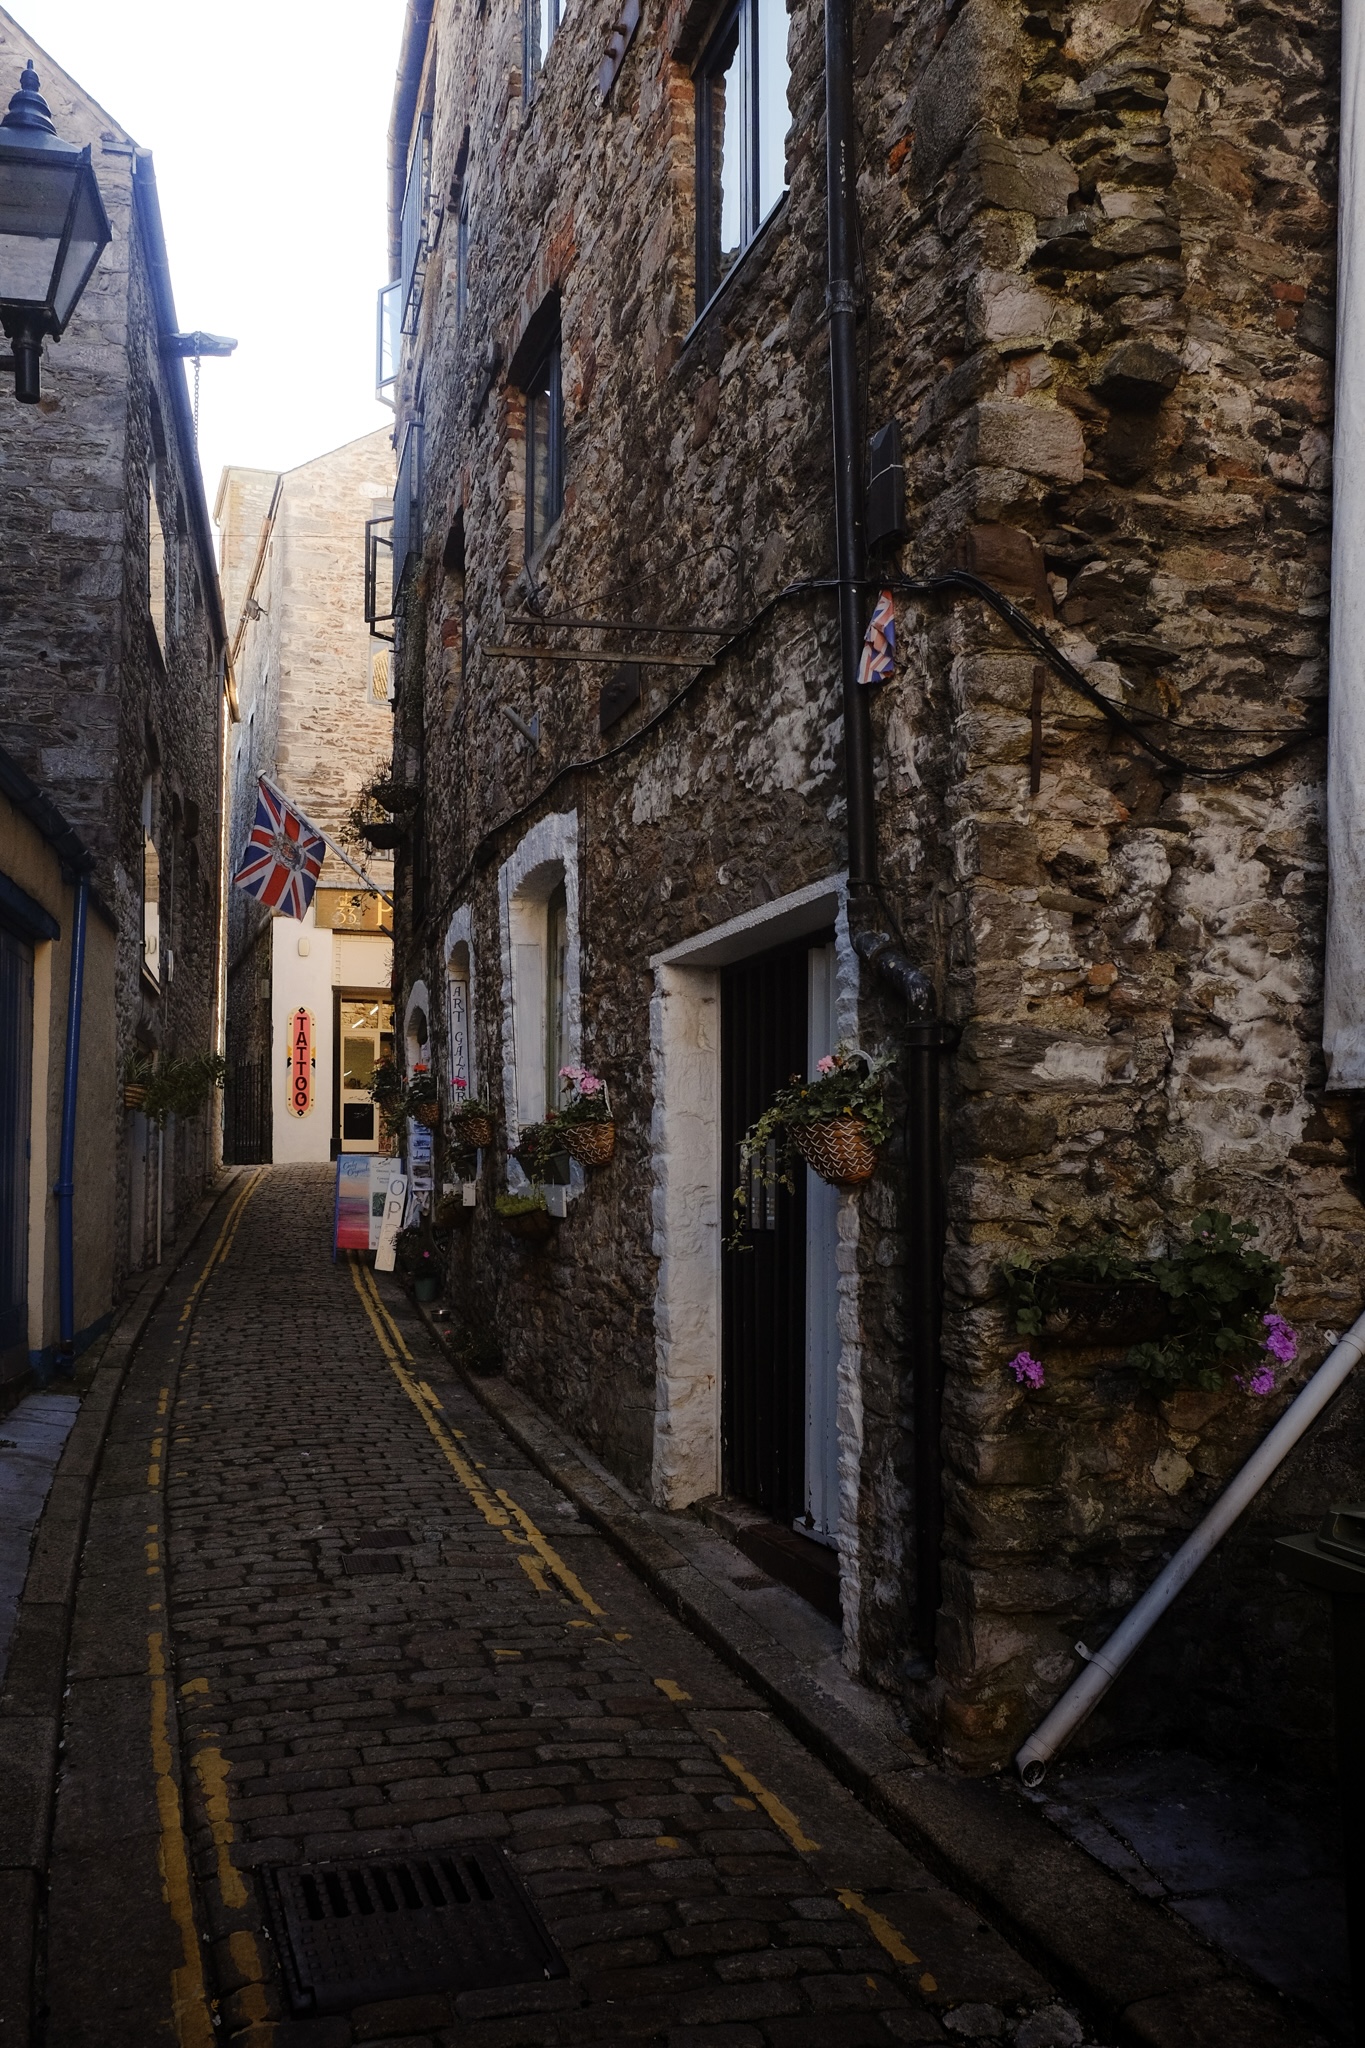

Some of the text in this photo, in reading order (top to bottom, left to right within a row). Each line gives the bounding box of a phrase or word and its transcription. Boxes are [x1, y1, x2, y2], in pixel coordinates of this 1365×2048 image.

[336, 906, 357, 925] 33
[295, 1017, 308, 1107] TATTOO
[452, 986, 467, 1102] ART GALLER
[377, 1180, 405, 1266] OPE
